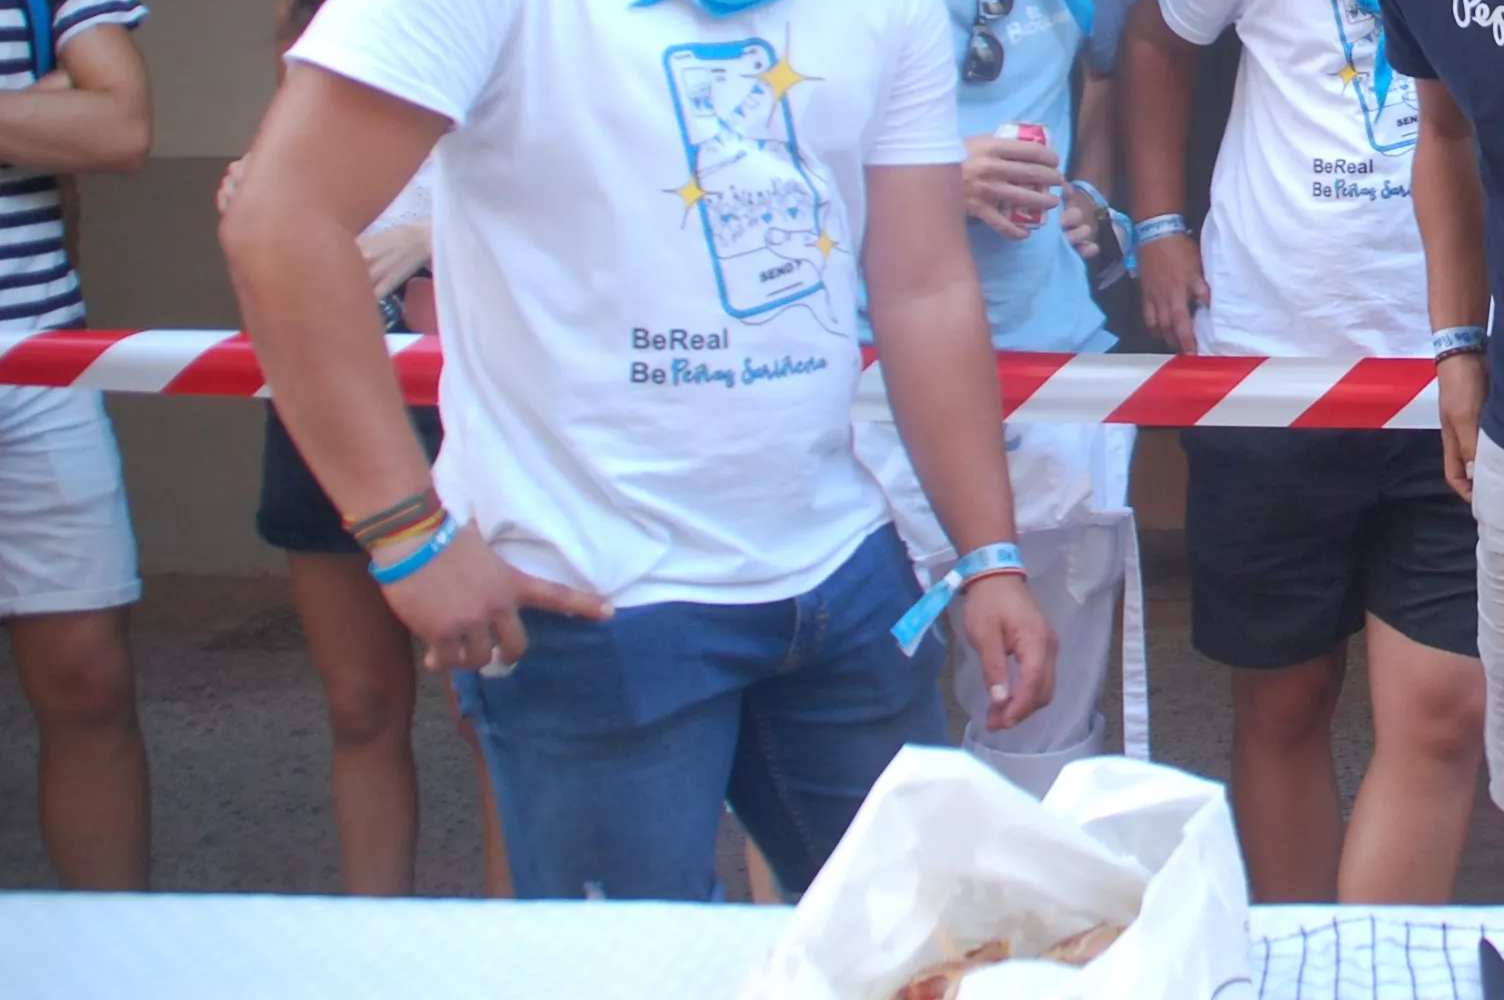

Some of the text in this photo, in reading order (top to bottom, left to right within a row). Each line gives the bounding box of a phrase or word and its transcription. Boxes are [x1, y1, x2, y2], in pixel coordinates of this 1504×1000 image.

[1396, 115, 1418, 127] SEN
[1313, 158, 1373, 174] BeReal
[1312, 181, 1332, 198] Be
[632, 327, 729, 350] BeReal
[631, 361, 666, 385] Be
